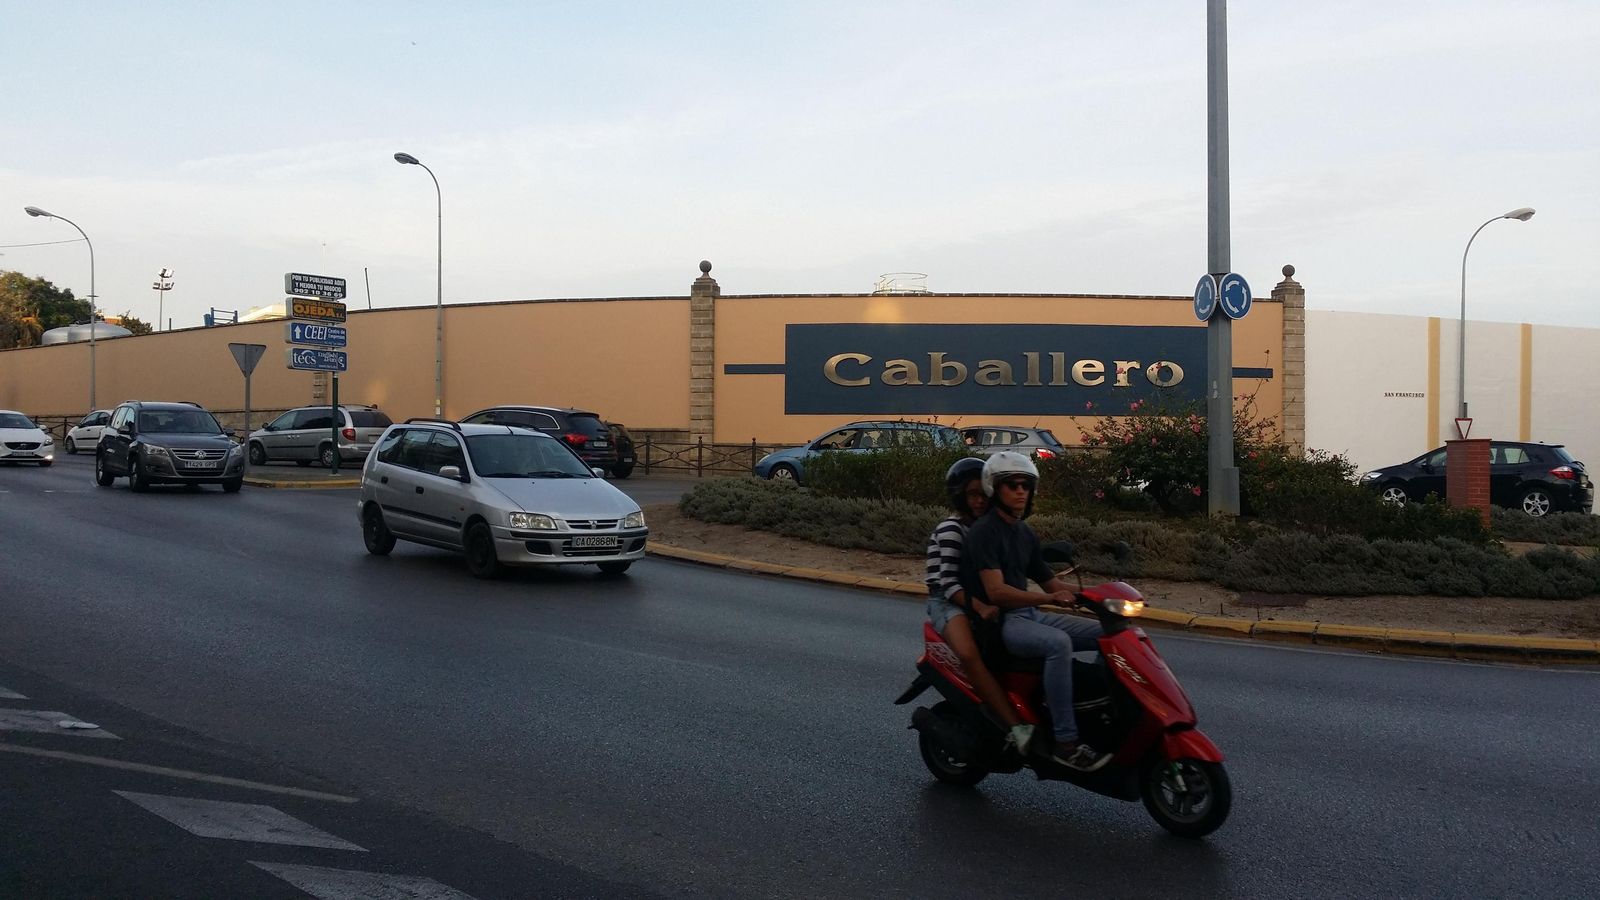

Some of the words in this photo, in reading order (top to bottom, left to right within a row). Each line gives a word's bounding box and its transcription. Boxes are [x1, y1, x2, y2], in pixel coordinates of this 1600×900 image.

[294, 304, 335, 317] OJEDA
[305, 325, 327, 340] CEEI
[294, 352, 316, 365] tecs
[823, 351, 1185, 388] Caballero
